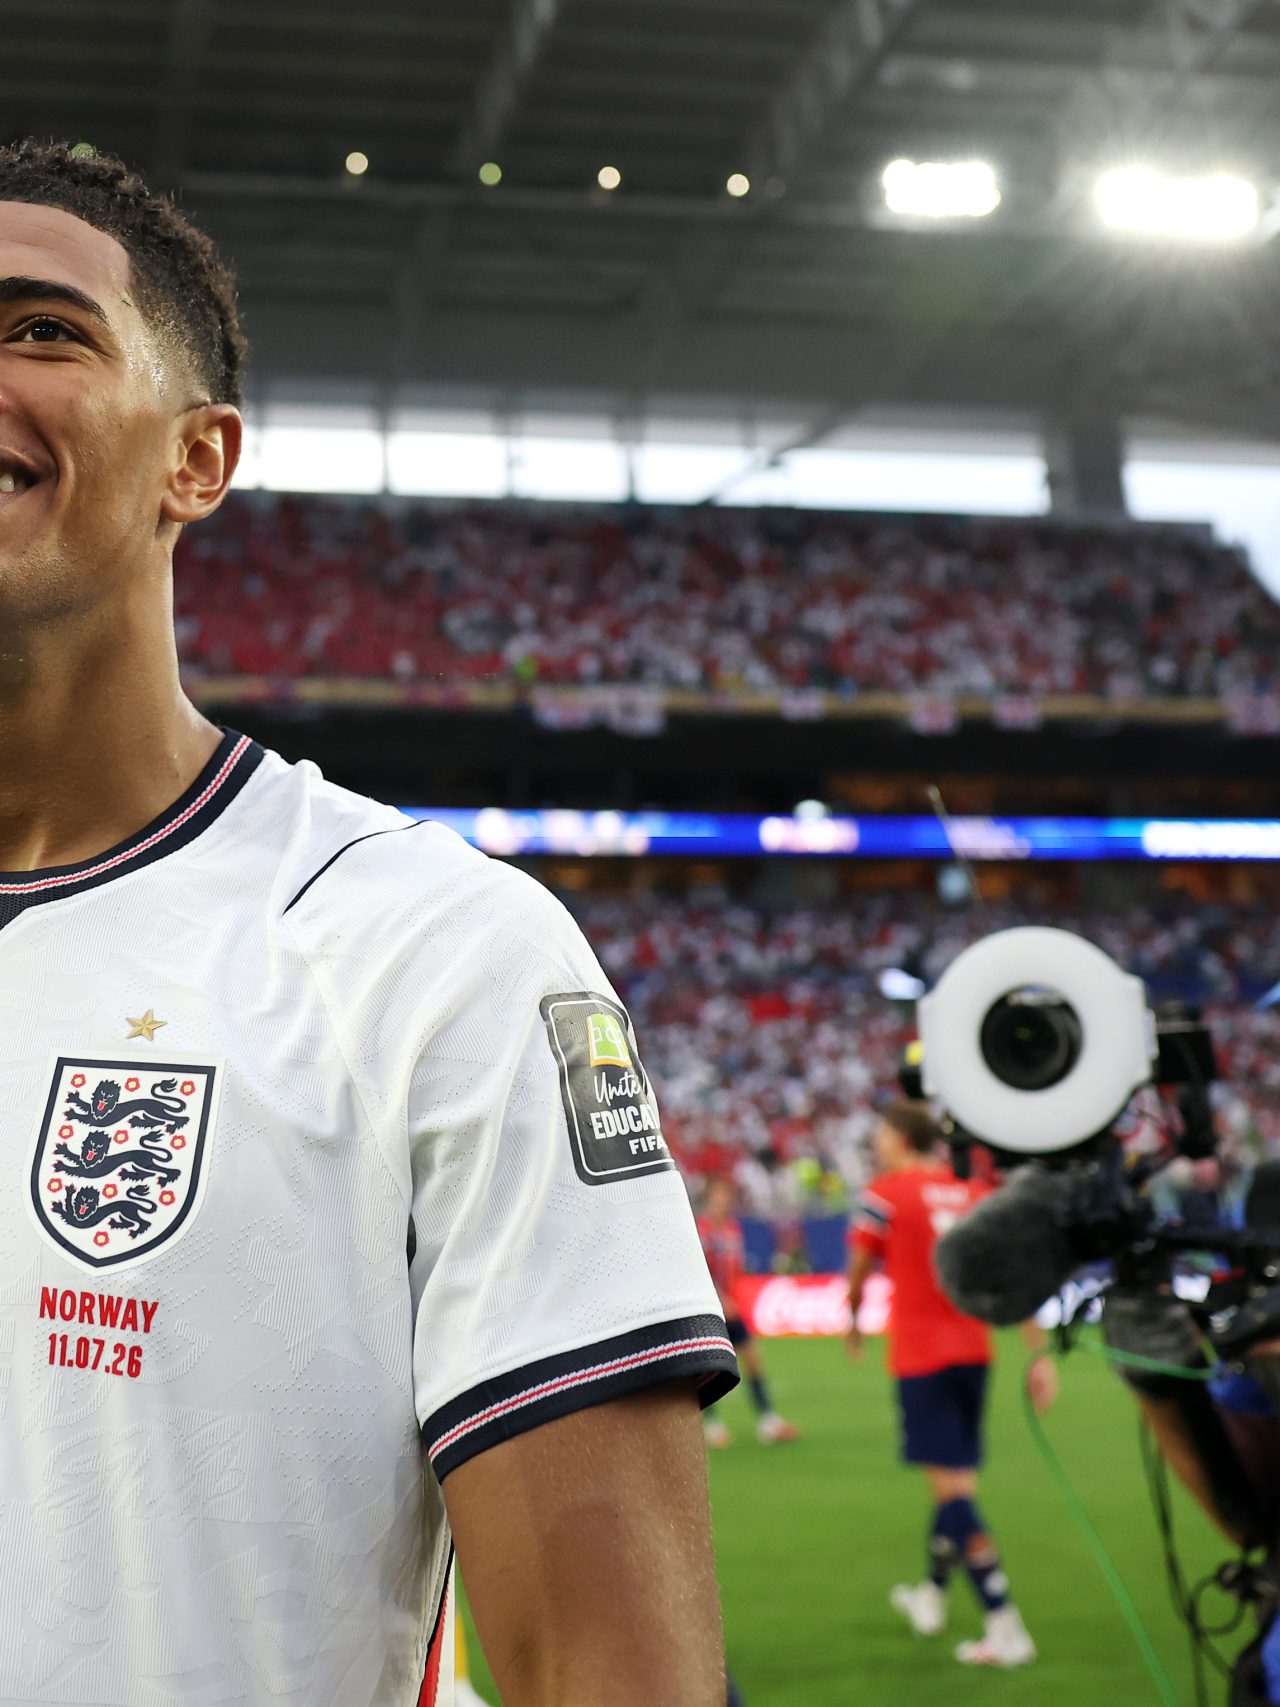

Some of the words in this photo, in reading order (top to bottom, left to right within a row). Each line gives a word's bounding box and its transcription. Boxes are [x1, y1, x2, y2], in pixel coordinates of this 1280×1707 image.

[628, 1134, 668, 1155] FIFA
[39, 1286, 160, 1334] NORWAY
[48, 1333, 143, 1379] 11.07.26
